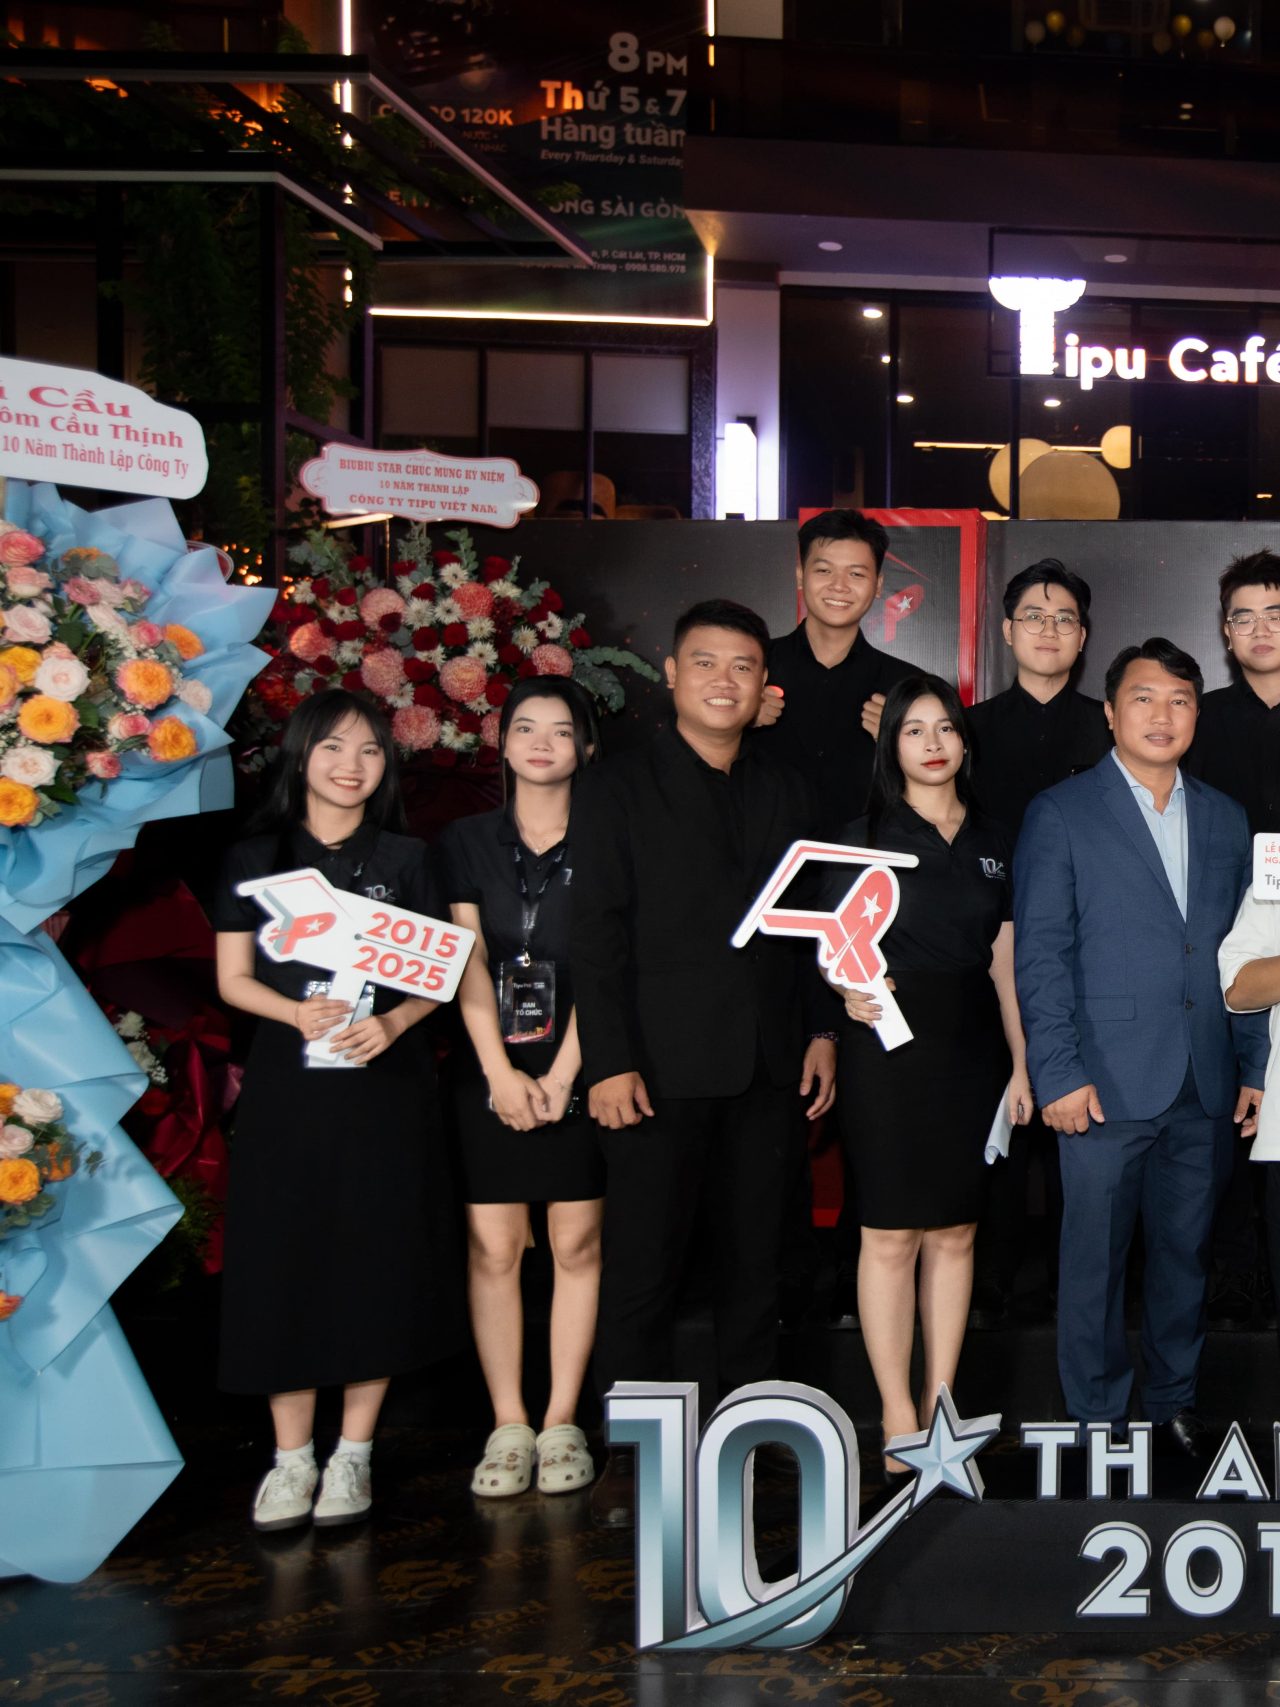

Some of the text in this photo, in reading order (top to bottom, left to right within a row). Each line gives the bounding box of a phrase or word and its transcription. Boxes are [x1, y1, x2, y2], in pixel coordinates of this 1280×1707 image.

[608, 31, 688, 77] 8 PM
[540, 80, 688, 117] Thứ 5 & 7
[461, 108, 513, 126] 120K
[540, 116, 686, 149] Hàng tuần
[540, 150, 572, 163] Every
[575, 150, 625, 166] Thursday
[601, 195, 634, 217] SÀI
[989, 276, 1146, 390] Tipu
[28, 386, 132, 419] Cầu
[51, 412, 99, 437] Cầu
[109, 423, 183, 449] Thịnh
[3, 436, 189, 479] 10 Năm Thành Lập Công Ty
[339, 459, 374, 472] BIUBIU
[377, 462, 402, 474] STAR
[380, 480, 390, 489] 10
[349, 493, 384, 505] CÔNG
[389, 496, 404, 507] TY
[407, 498, 436, 509] TIPU
[441, 500, 467, 512] VIỆT
[366, 912, 461, 959] 2015
[352, 945, 449, 991] 2025
[605, 1381, 860, 1652] 10
[1020, 1422, 1153, 1499] TH
